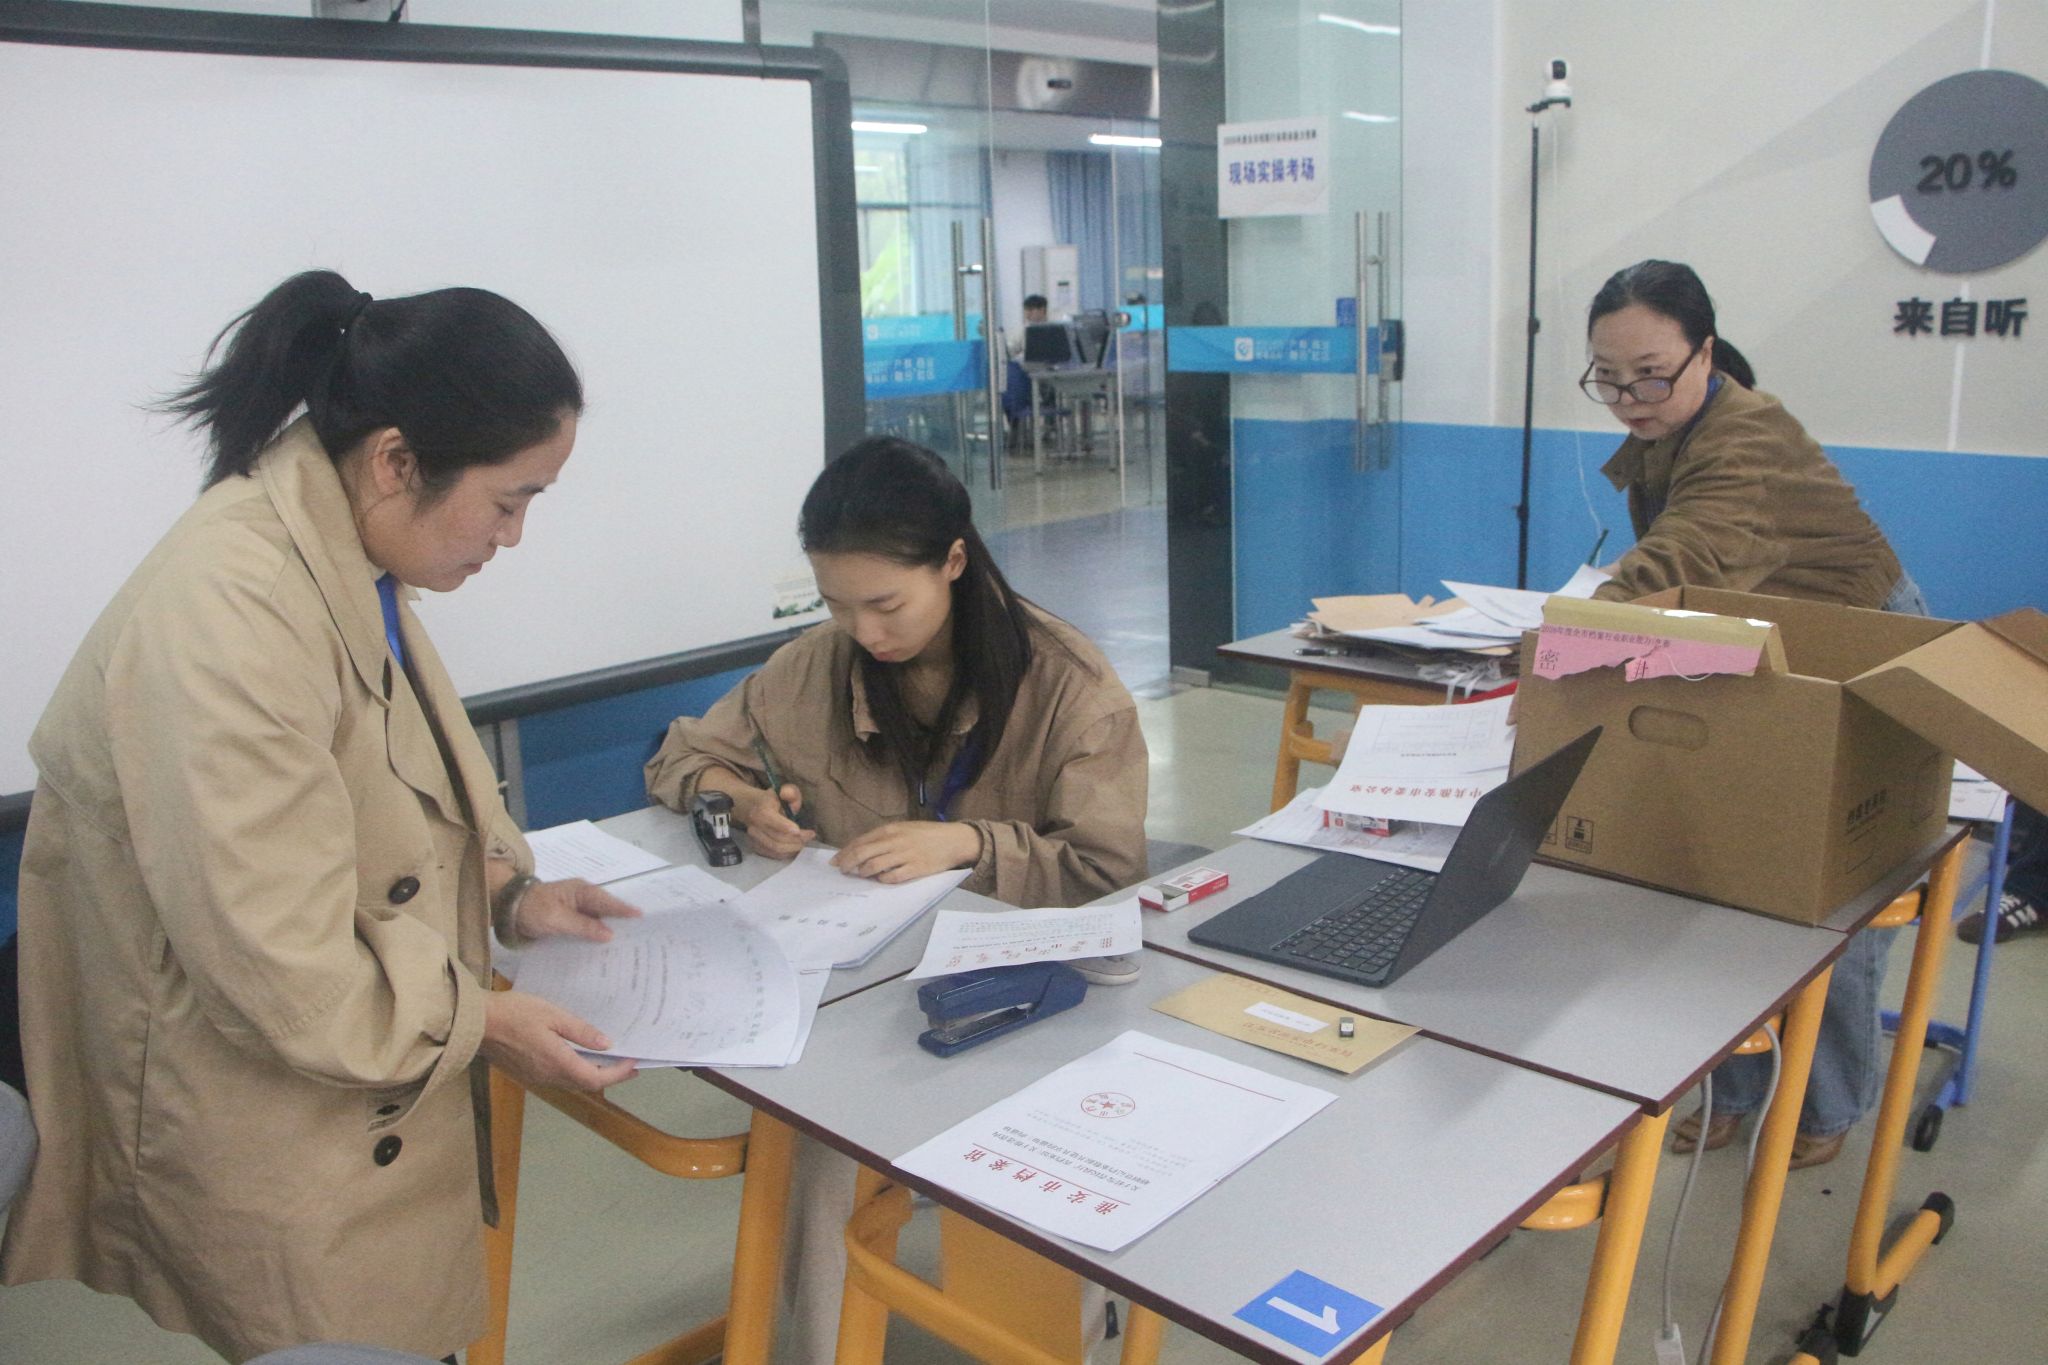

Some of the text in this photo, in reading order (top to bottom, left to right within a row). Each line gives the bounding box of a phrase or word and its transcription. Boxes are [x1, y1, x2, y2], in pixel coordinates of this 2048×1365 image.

[1229, 158, 1315, 184] 现场实操考场
[1917, 150, 2017, 193] 20%
[1894, 297, 2028, 337] 来自听
[959, 1148, 1120, 1216] 淮安市档案馆
[1266, 1296, 1340, 1335] 1
